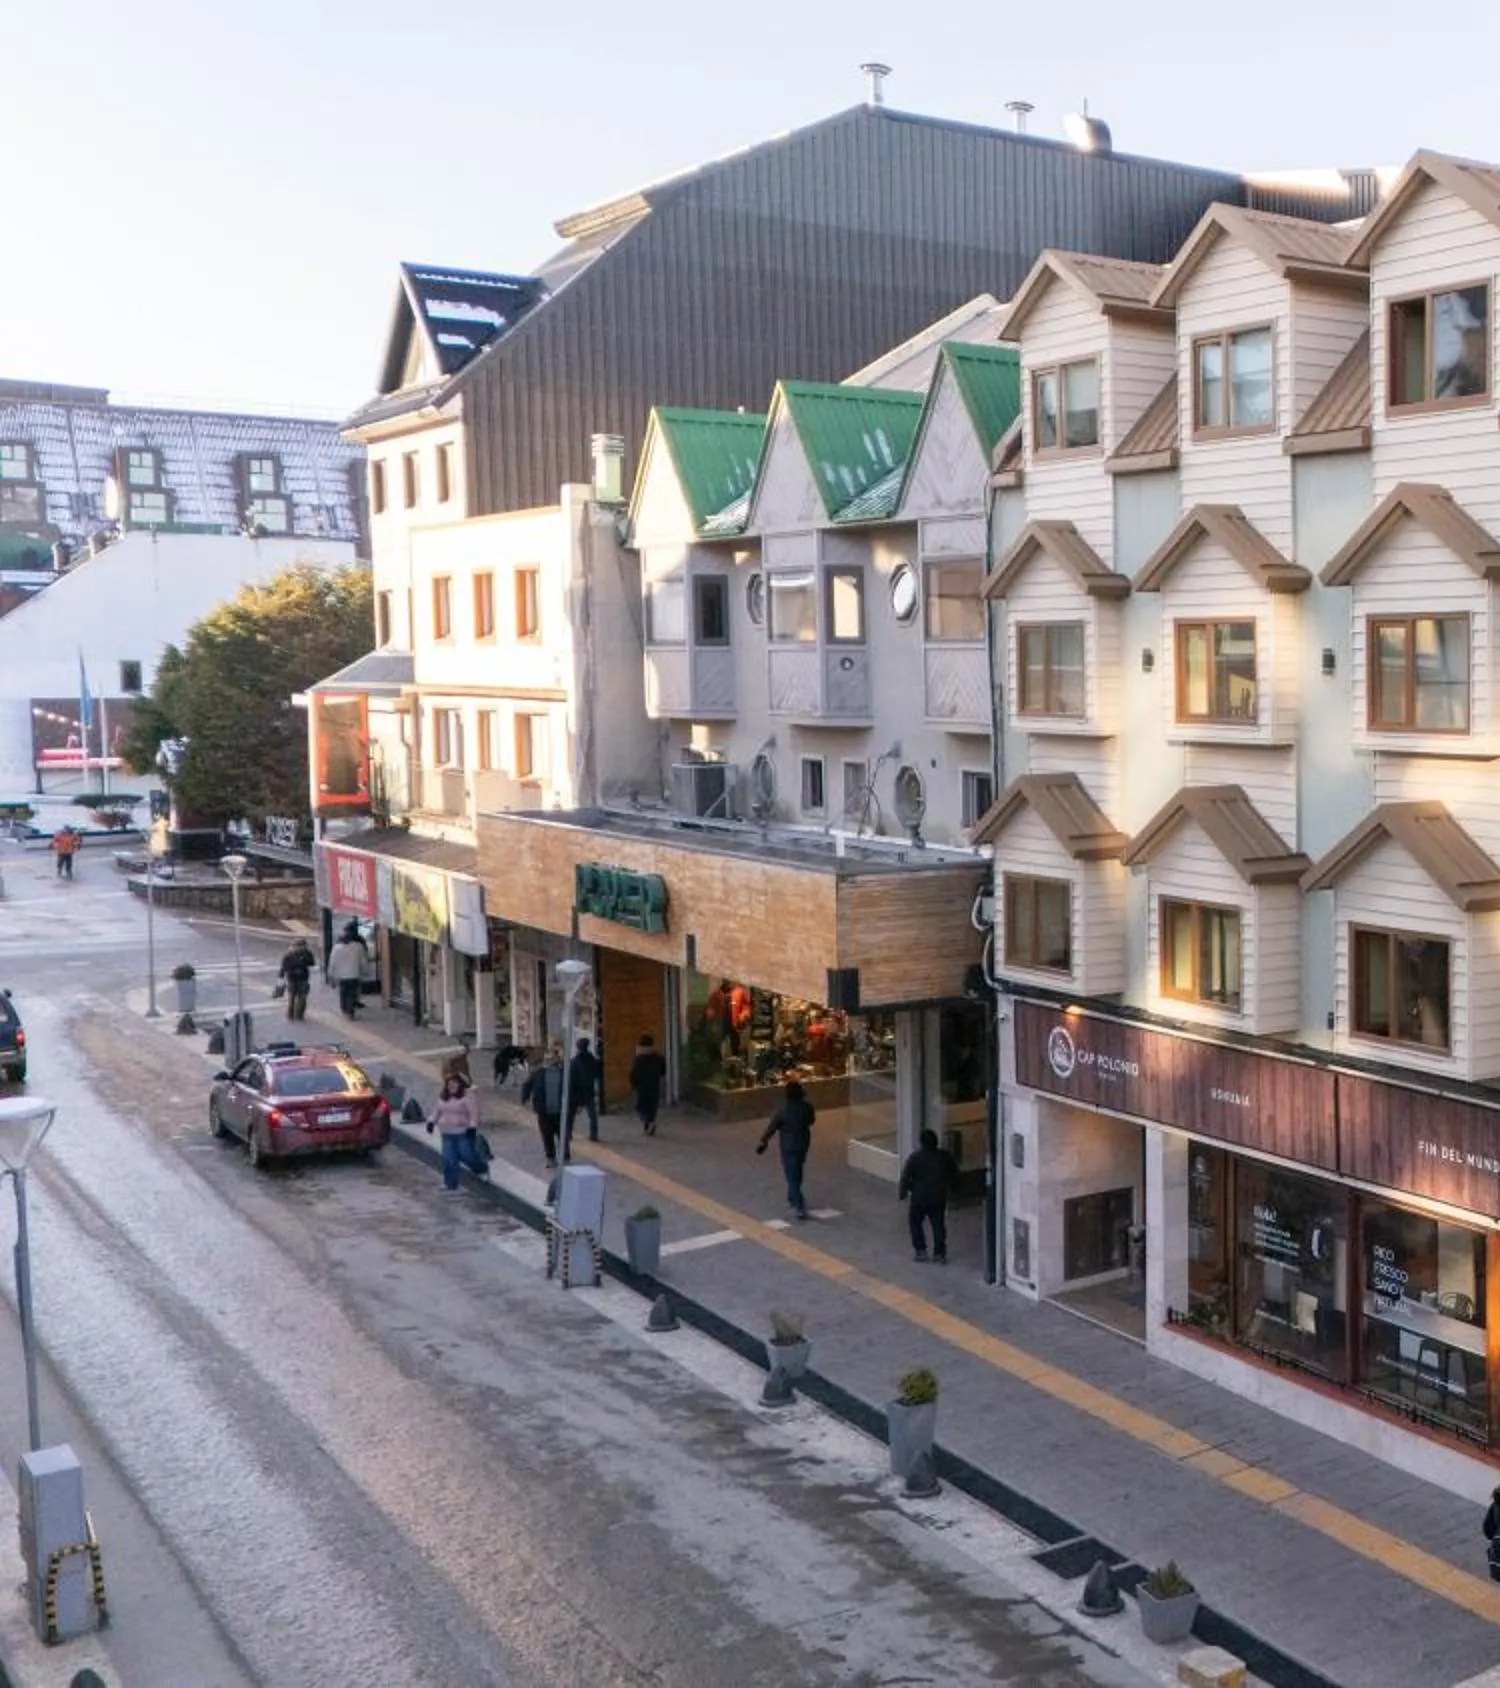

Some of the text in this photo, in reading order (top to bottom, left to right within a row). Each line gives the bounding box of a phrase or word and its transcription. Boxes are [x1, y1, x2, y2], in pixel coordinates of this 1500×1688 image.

[1077, 1049, 1096, 1065] CAP
[1098, 1054, 1139, 1077] POLONIO
[1418, 1141, 1437, 1157] FIN
[1442, 1146, 1463, 1163] DEL
